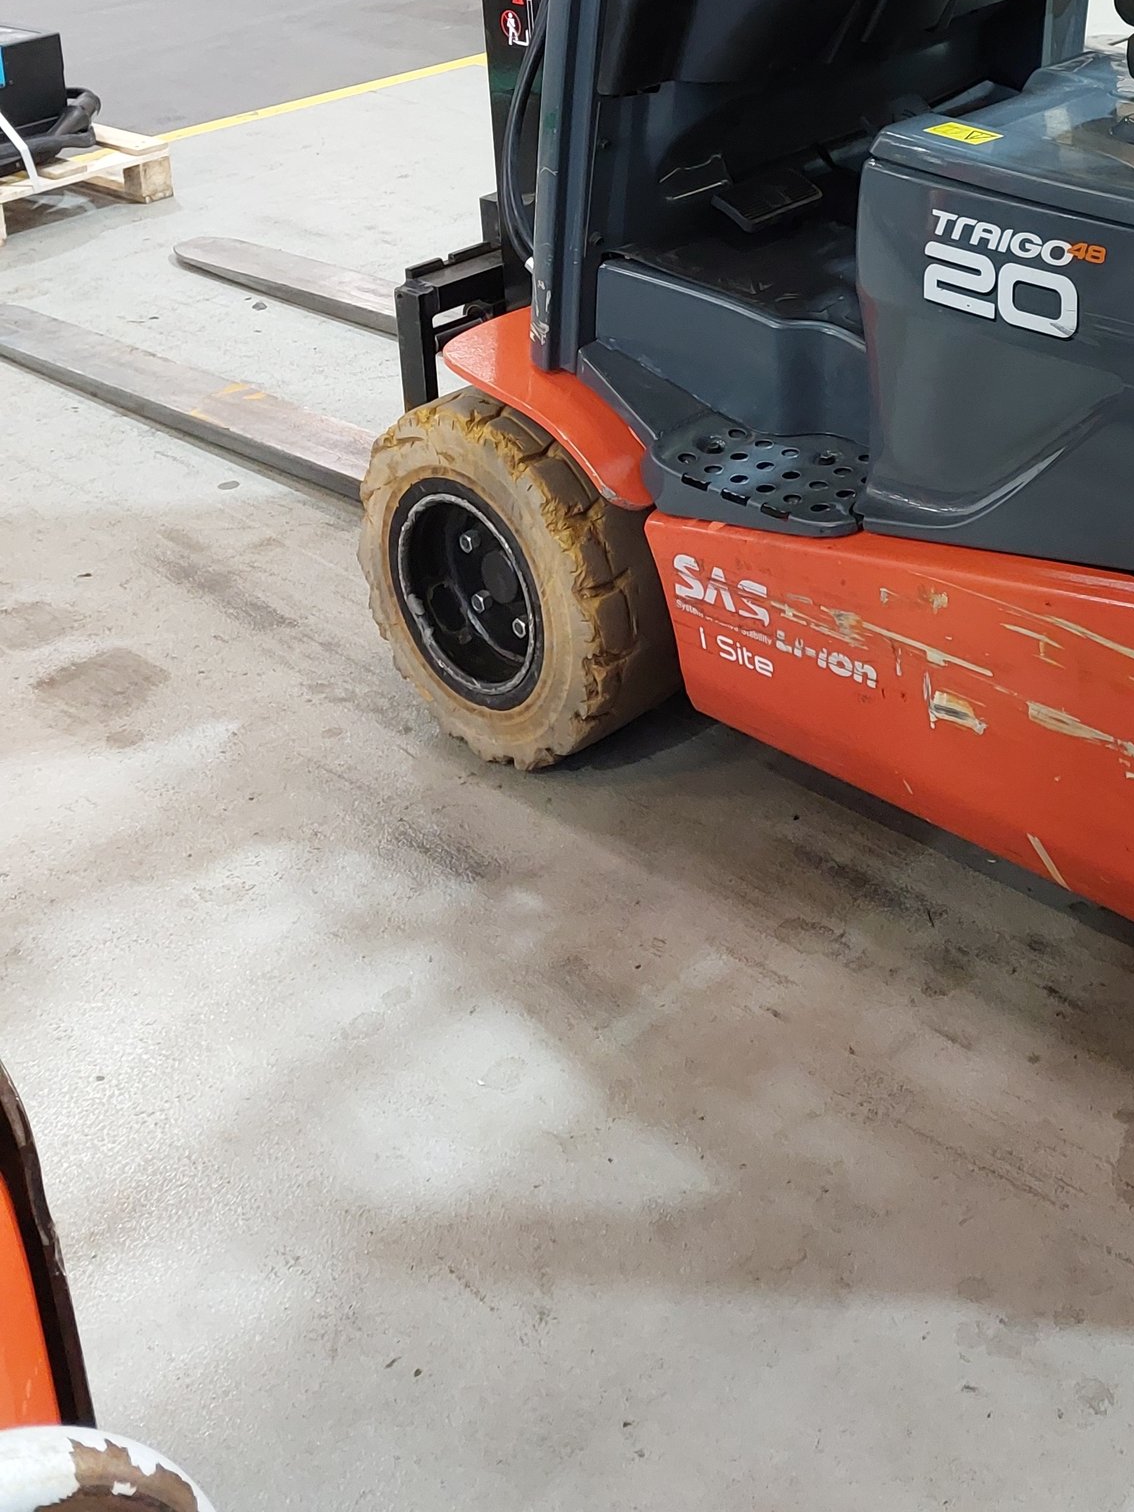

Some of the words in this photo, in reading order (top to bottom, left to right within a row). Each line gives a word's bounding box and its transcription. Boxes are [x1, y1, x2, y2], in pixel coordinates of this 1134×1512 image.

[923, 240, 1078, 339] 20
[673, 554, 770, 627] SAS
[716, 635, 774, 678] Site
